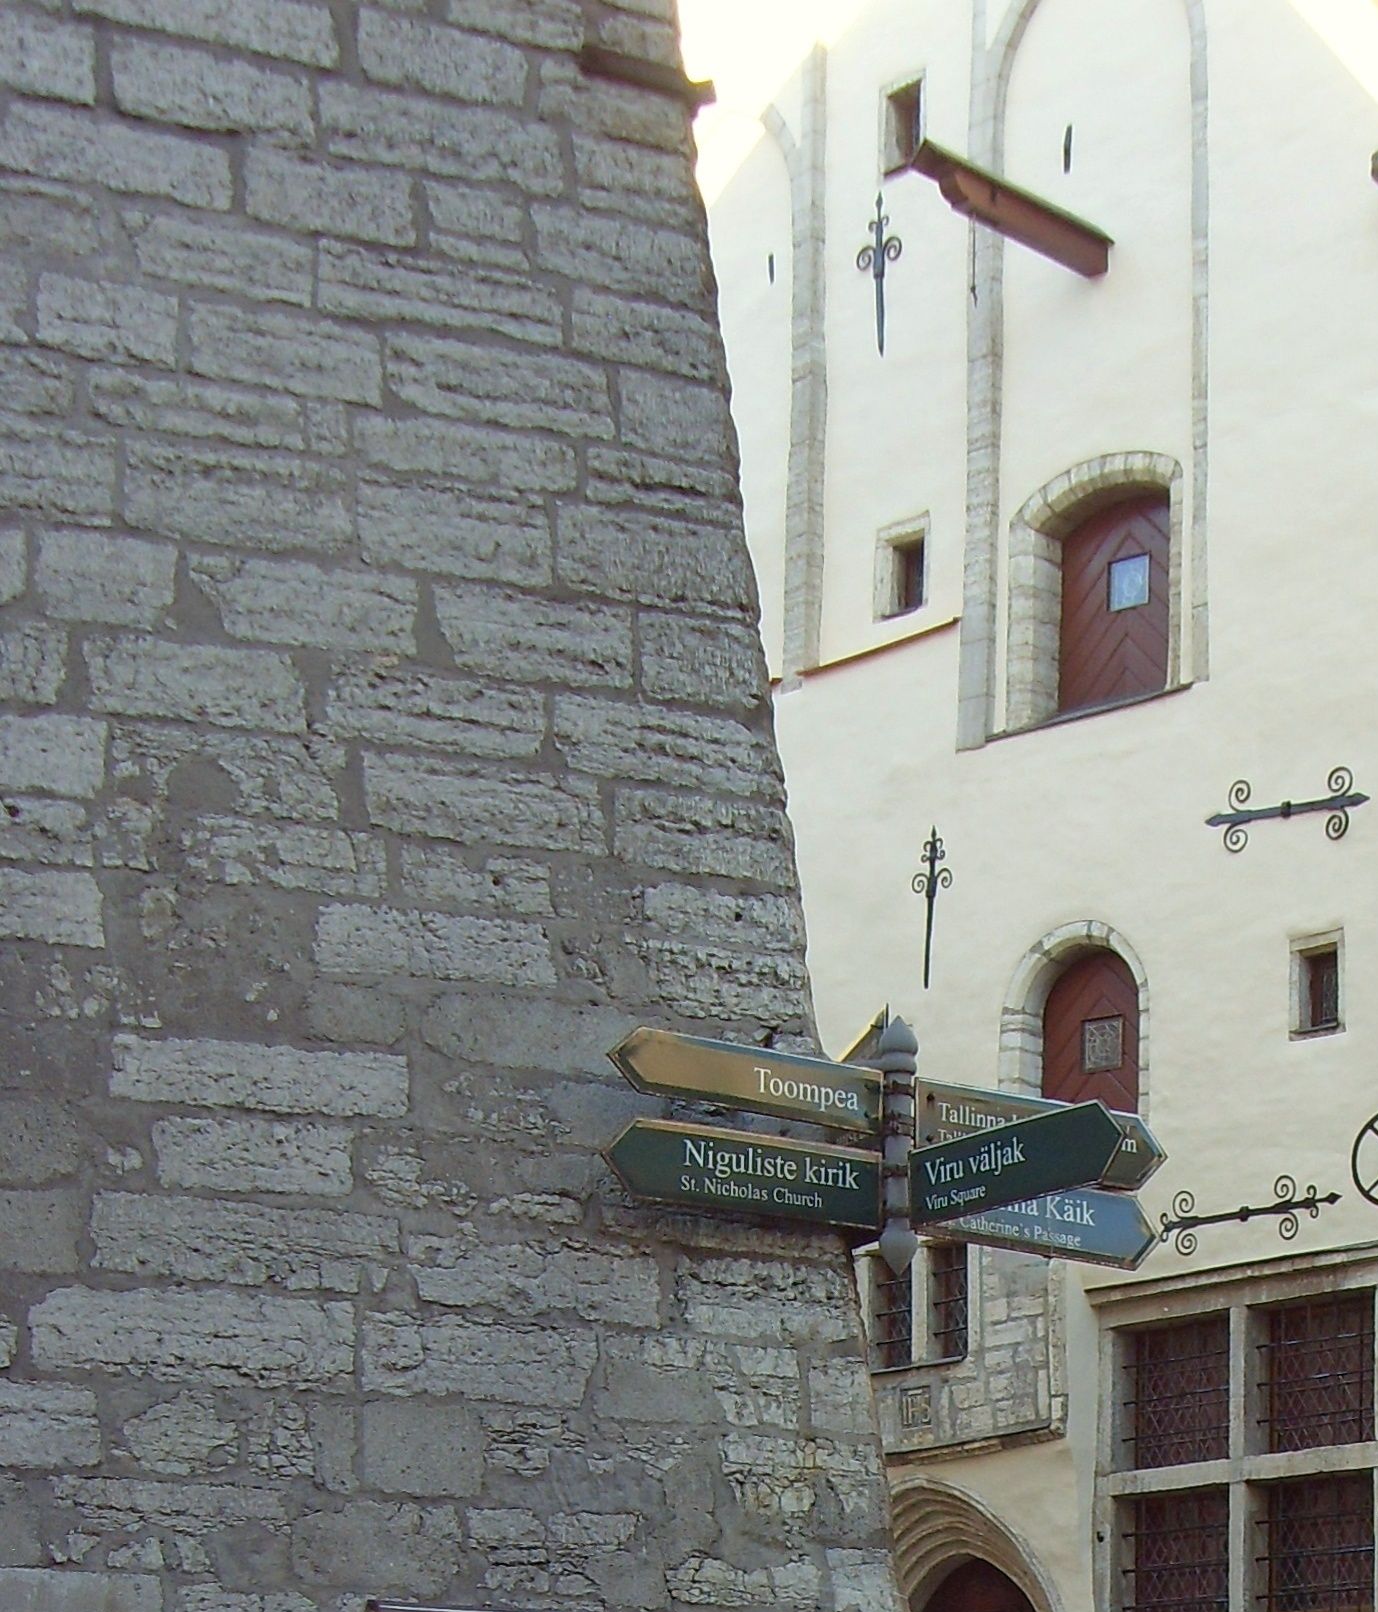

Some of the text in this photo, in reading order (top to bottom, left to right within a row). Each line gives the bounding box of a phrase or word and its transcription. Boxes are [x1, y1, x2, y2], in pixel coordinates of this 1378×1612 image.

[754, 1066, 859, 1112] Toompea
[683, 1139, 861, 1190] Niguliste kirik
[925, 1136, 1027, 1187] Viru väljak
[680, 1174, 823, 1208] St. Nicholas Church
[925, 1184, 986, 1211] Viru Square
[1045, 1195, 1095, 1226] Käik
[1034, 1224, 1082, 1248] Passage
